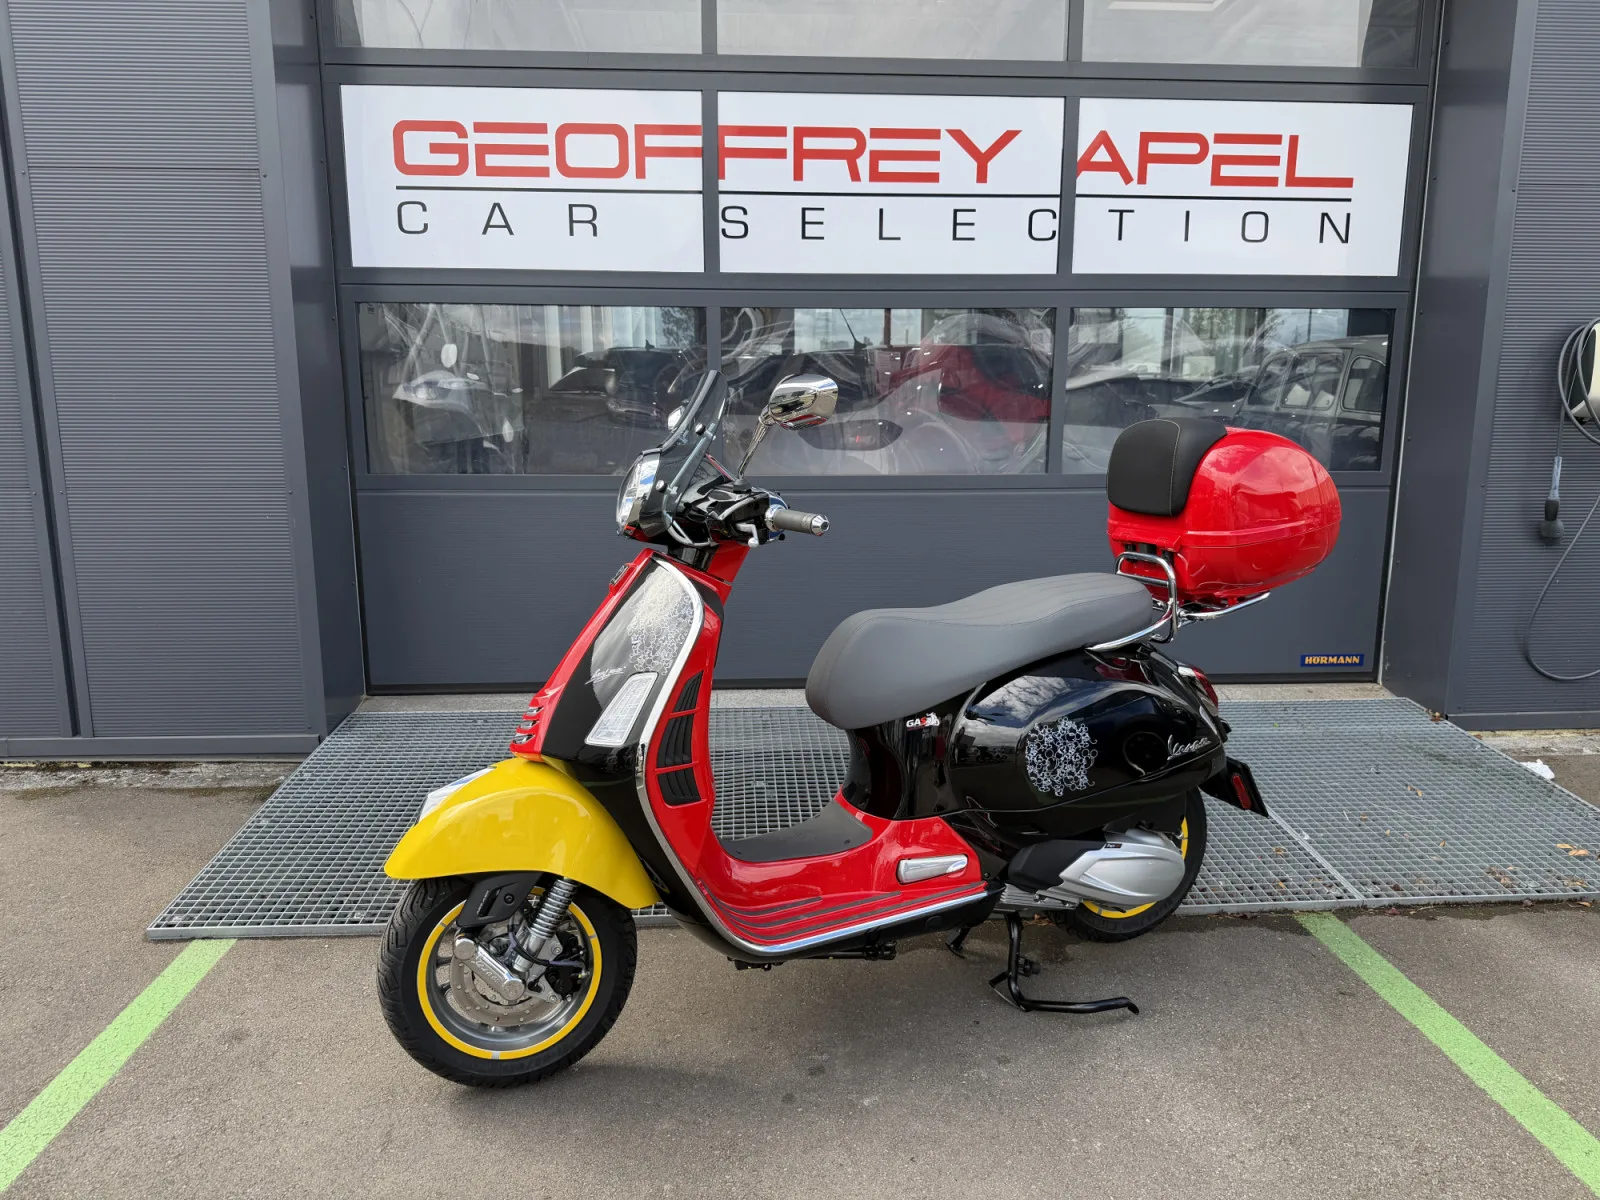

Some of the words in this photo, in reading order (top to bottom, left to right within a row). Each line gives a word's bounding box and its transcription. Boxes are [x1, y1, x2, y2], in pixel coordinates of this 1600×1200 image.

[393, 119, 1022, 184] GEOFFREY
[1077, 130, 1354, 188] APEL
[396, 200, 598, 238] CAR
[720, 206, 1352, 244] SELECTION
